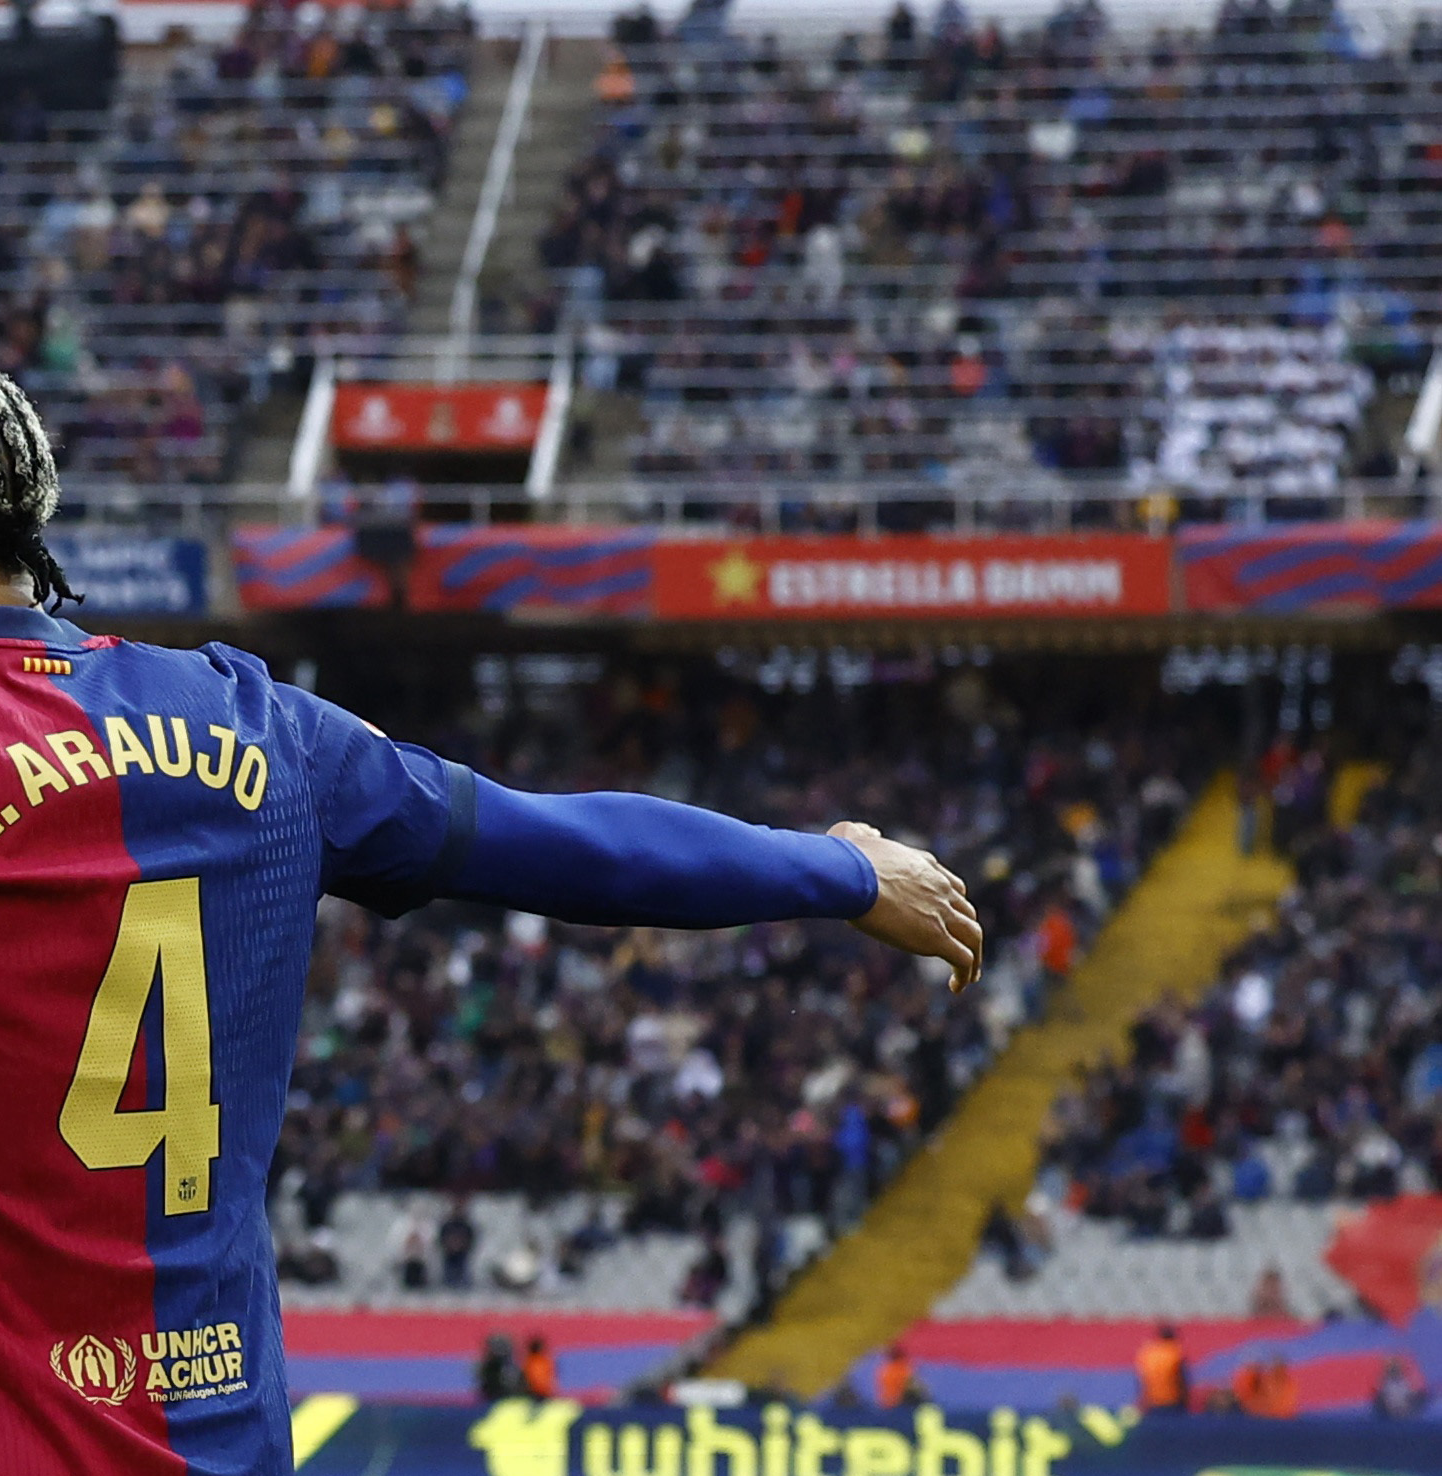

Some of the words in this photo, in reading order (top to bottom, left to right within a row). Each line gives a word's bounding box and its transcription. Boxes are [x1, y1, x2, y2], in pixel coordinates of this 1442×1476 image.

[5, 714, 268, 811] ARAUJO
[58, 875, 220, 1216] 4
[141, 1322, 243, 1360] UNHCR
[146, 1351, 243, 1390] ACNUR
